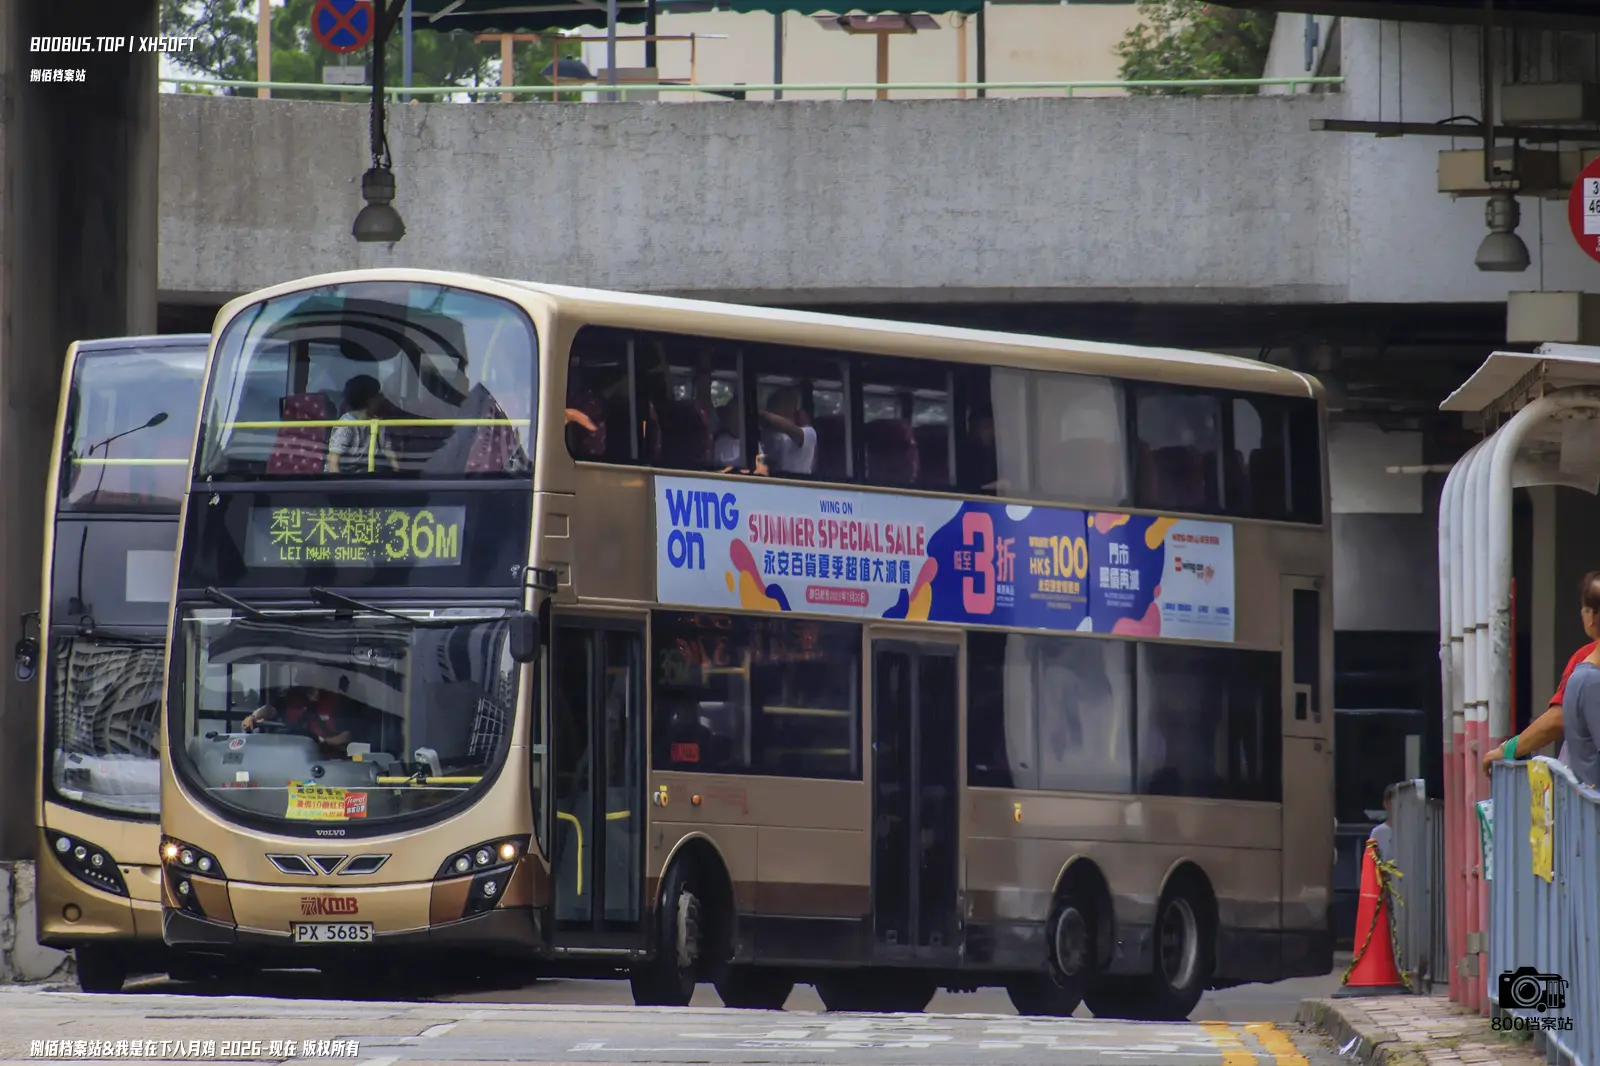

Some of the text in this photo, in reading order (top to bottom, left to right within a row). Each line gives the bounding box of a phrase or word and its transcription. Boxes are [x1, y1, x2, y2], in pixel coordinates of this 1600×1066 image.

[819, 499, 853, 515] WING ON
[386, 510, 458, 559] 36M
[747, 514, 925, 557] SUMMER SPECIAL SALE
[280, 547, 301, 560] LEI
[334, 547, 366, 561] SHUE
[316, 897, 359, 915] KMB
[298, 925, 369, 940] PX 5685
